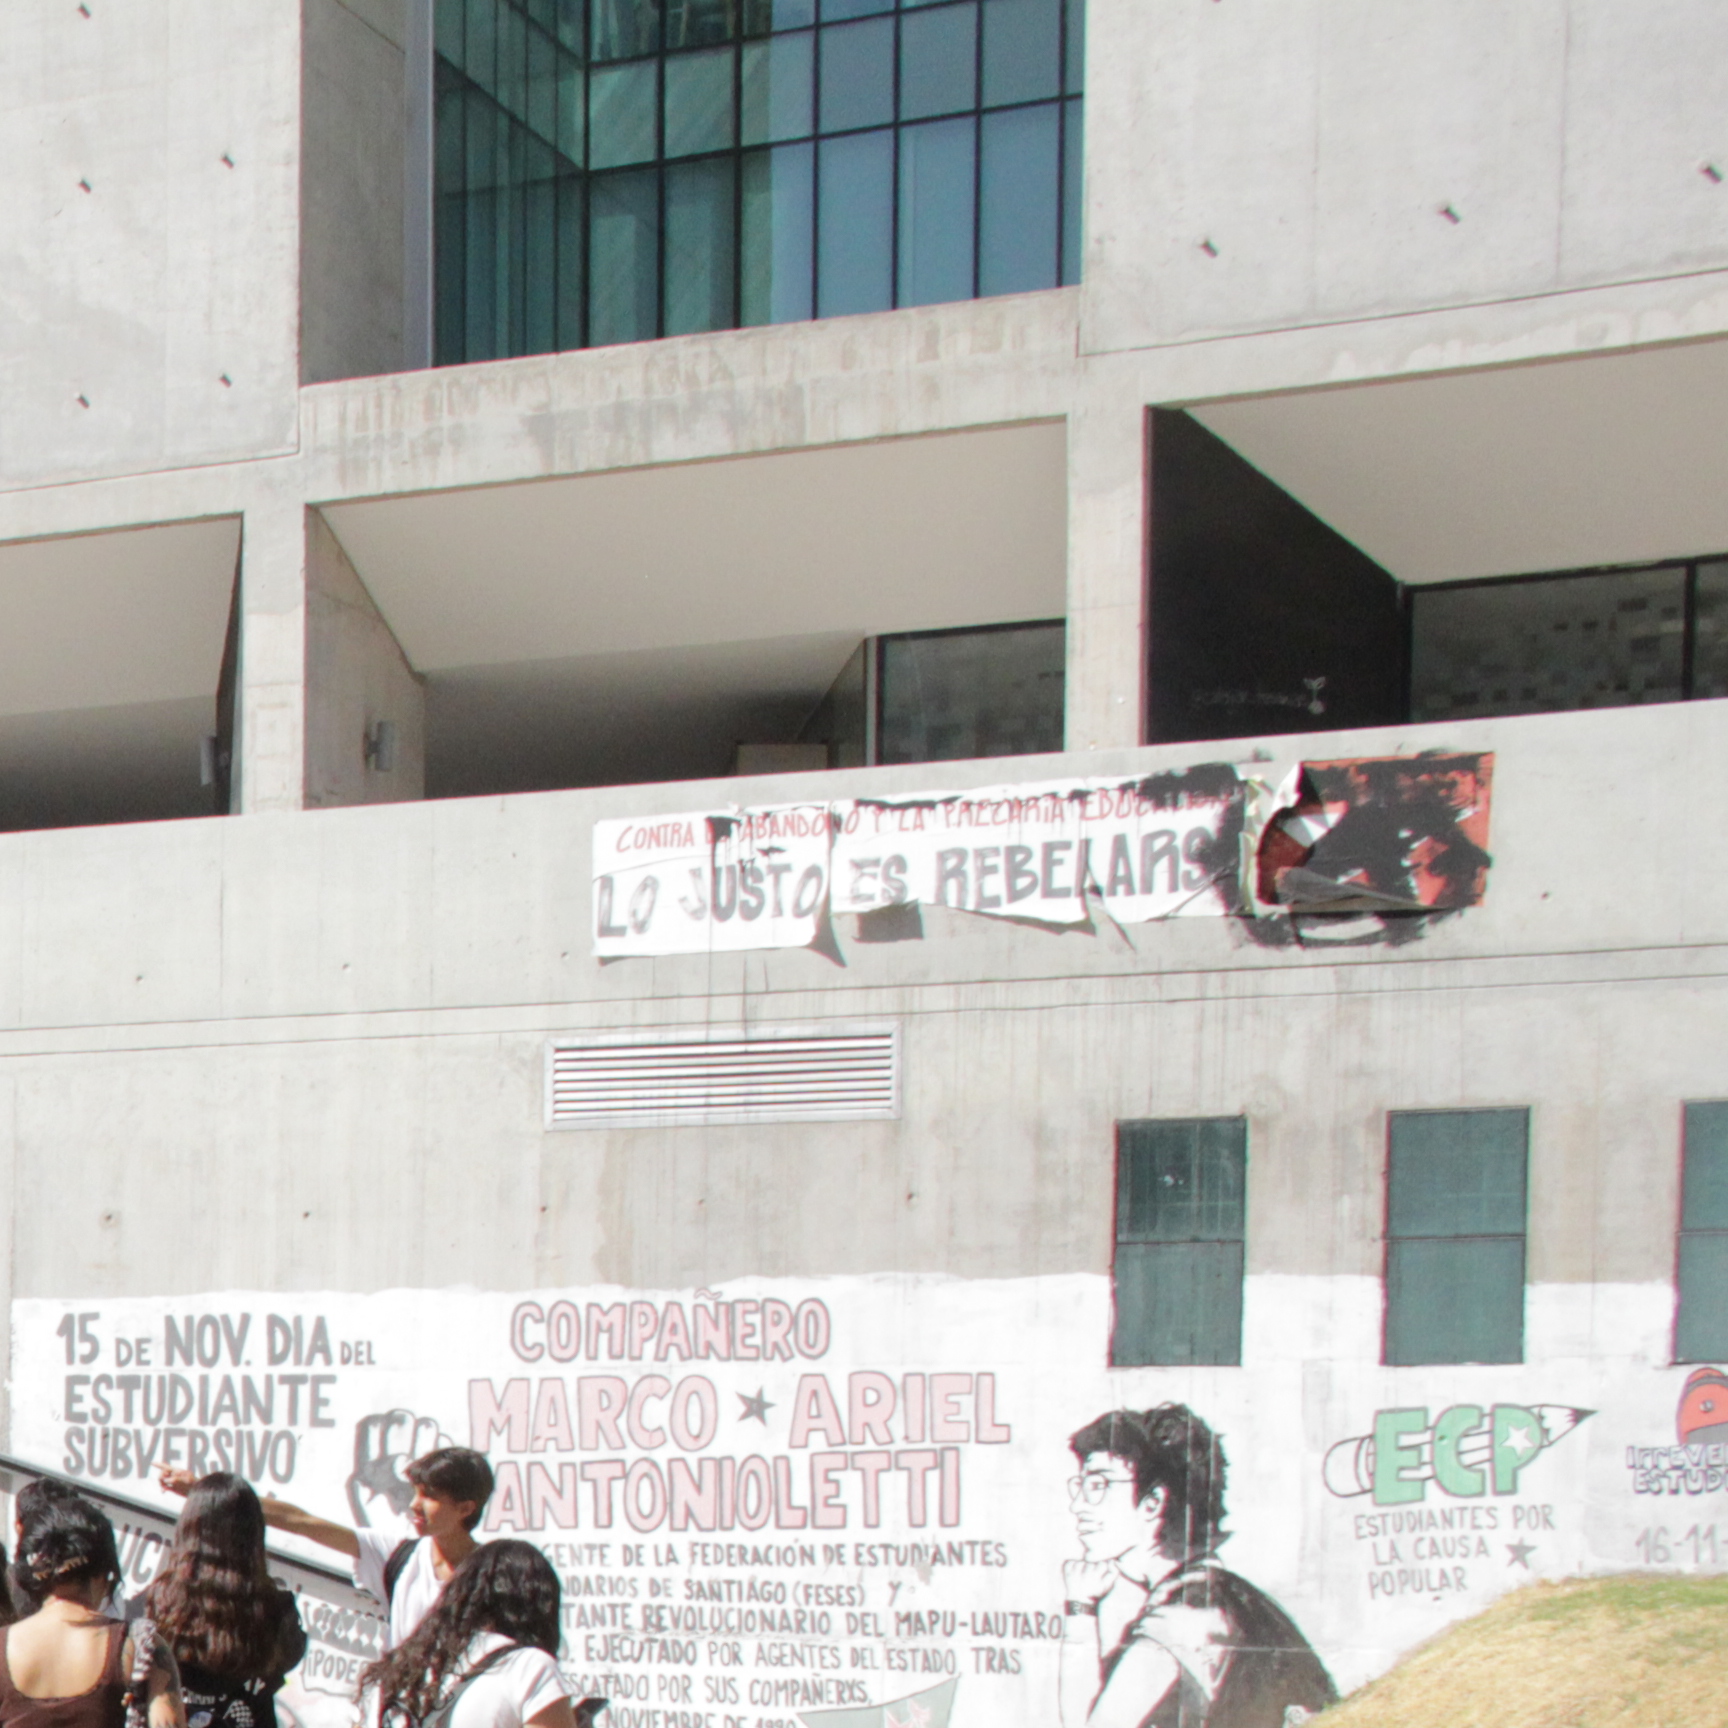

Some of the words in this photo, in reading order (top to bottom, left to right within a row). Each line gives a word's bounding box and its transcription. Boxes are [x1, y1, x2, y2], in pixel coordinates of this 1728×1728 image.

[616, 821, 695, 853] CONTRA
[898, 807, 925, 832] LA
[597, 873, 660, 939] LO
[677, 863, 824, 923] JUSTO
[849, 854, 909, 904] ES
[56, 1312, 100, 1367] 15
[114, 1337, 152, 1368] DE
[164, 1312, 251, 1368] NOV.
[266, 1313, 333, 1367] DIA
[340, 1340, 376, 1366] DEL
[510, 1287, 831, 1362] COMPAÑERO
[64, 1372, 337, 1428] ESTUDIANTE
[467, 1373, 719, 1454] MARCO
[787, 1370, 1011, 1449] ARIEL
[62, 1426, 297, 1484] SUBVERSIVO
[1372, 1402, 1545, 1508] ECP
[482, 1447, 960, 1534] ANTONIOLETTI
[1632, 1470, 1728, 1497] ESTUD
[1353, 1505, 1499, 1541] ESTUDIANTES
[1512, 1503, 1556, 1531] POR
[622, 1543, 645, 1568] DE
[653, 1542, 680, 1567] LA
[688, 1538, 817, 1568] FEDERACIÓN
[822, 1543, 846, 1567] DE
[854, 1540, 1008, 1568] ESTUDIANTES
[1372, 1538, 1404, 1567] LA
[1413, 1534, 1491, 1561] CAUSA
[648, 1577, 673, 1600] DE
[683, 1578, 787, 1606] SANTIAGO
[792, 1579, 866, 1607] (FESES)
[887, 1580, 903, 1608] Y
[1367, 1565, 1469, 1601] POPULAR
[641, 1603, 832, 1636] REVOLUCIONARIO
[845, 1611, 885, 1638] DEL
[584, 1633, 697, 1666] EJECUTADO
[706, 1640, 744, 1667] POR
[754, 1642, 841, 1670] AGENTES
[850, 1646, 880, 1670] DEL
[970, 1646, 1022, 1675] TRAS
[657, 1673, 693, 1704] POR
[703, 1675, 740, 1706] SUS
